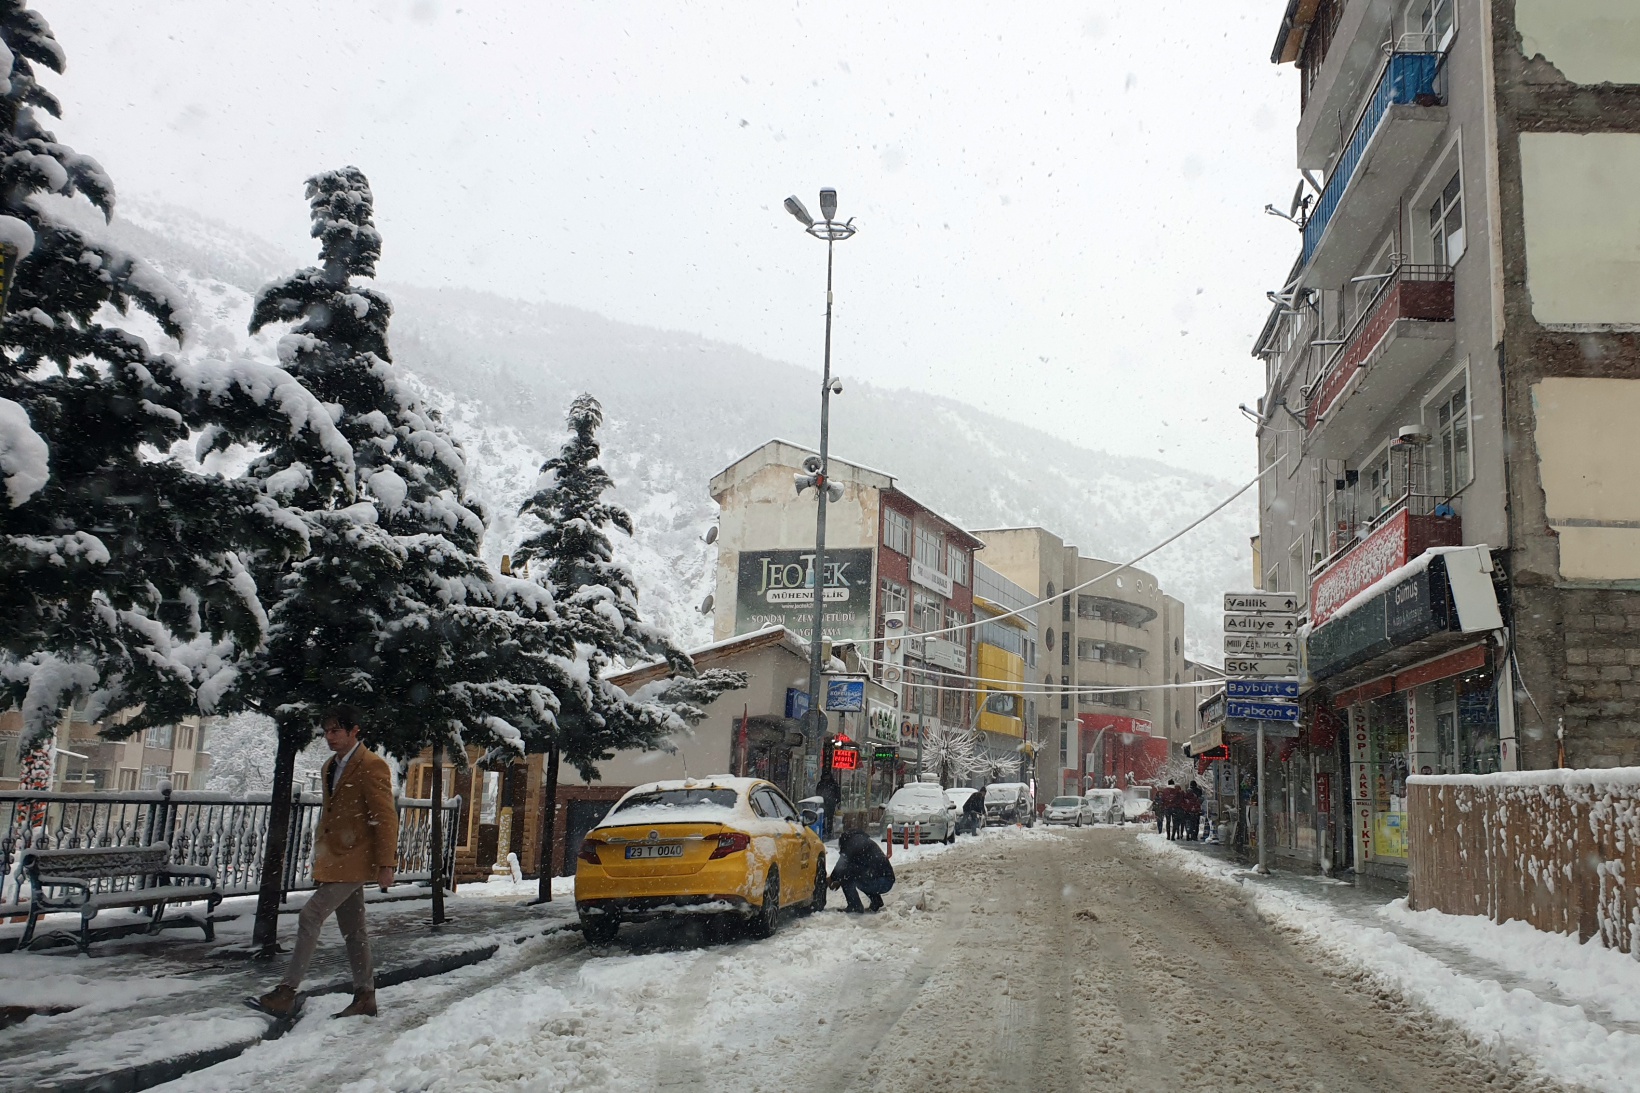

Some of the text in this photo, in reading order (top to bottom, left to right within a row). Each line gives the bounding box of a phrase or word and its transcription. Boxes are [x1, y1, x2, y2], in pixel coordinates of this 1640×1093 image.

[771, 590, 844, 599] MÜHENSLİK
[1227, 599, 1267, 608] Valilik
[751, 614, 786, 624] SONDAJ
[1227, 618, 1275, 630] Adliye
[1227, 662, 1259, 672] SGK
[1228, 683, 1280, 694] Bayburt
[1230, 704, 1282, 717] Trabzon
[1359, 764, 1368, 798] FAKS
[630, 846, 682, 857] 29 T 0040
